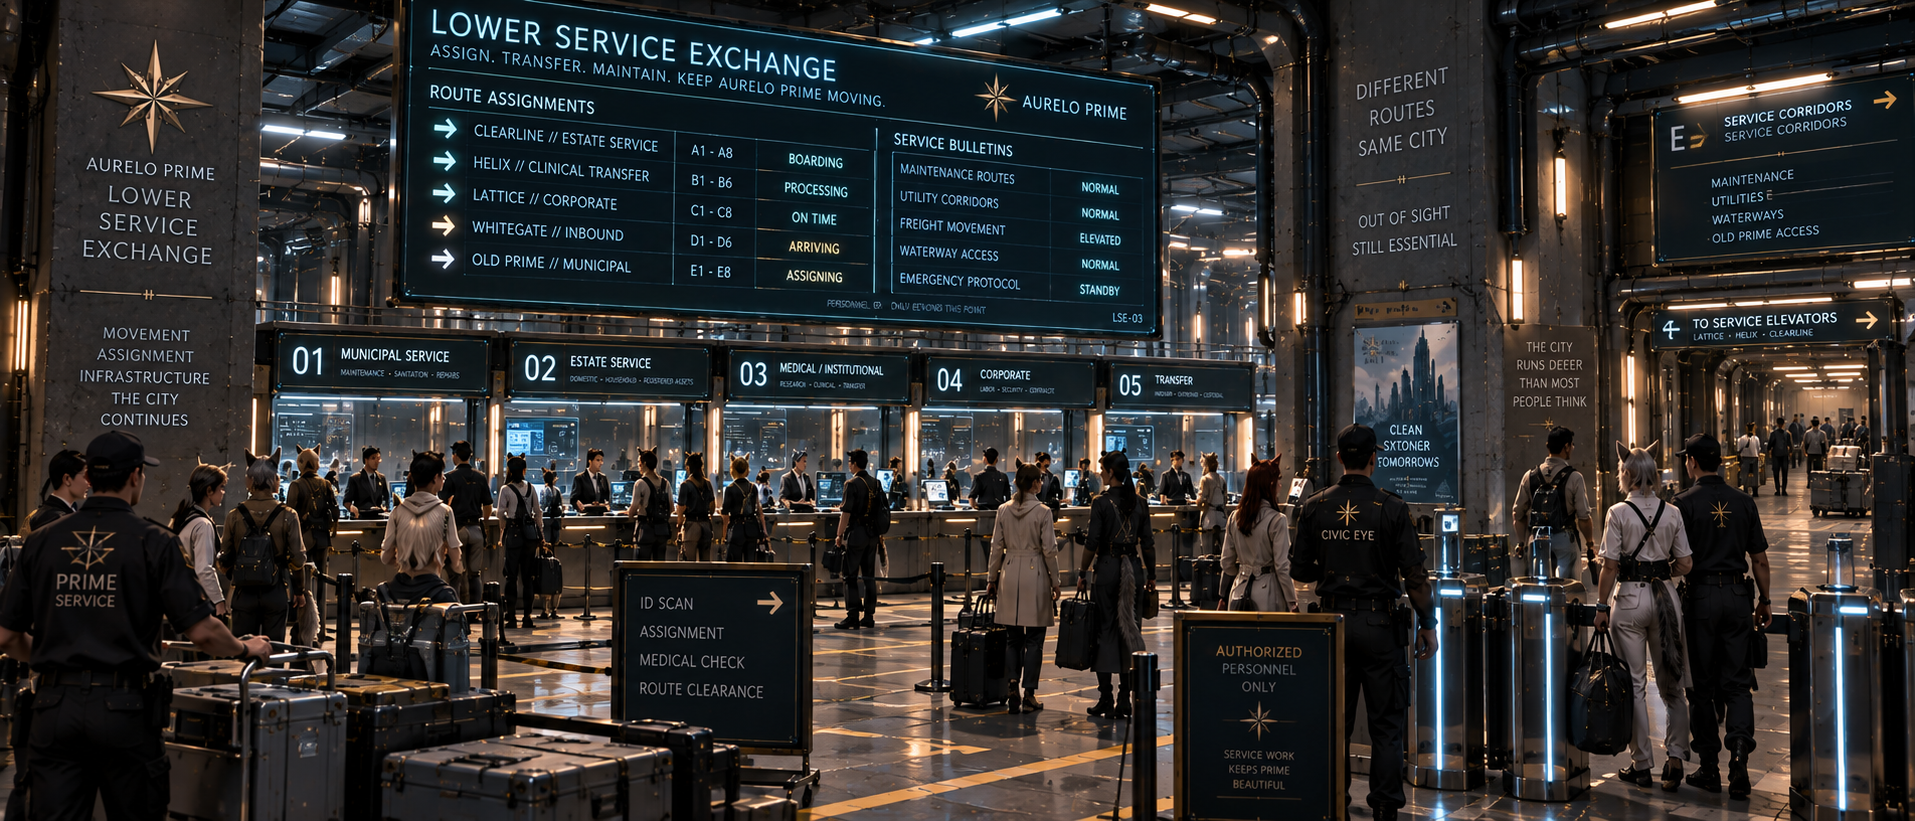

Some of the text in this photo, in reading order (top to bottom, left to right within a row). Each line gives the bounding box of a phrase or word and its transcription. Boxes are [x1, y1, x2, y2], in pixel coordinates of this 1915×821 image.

[432, 8, 836, 84] LOWER SERVICE EXCHANGE
[430, 44, 886, 108] ASSIGN. TRANSFER. MAINTAIN. KEEP AURELO PRIME MOVING.
[1356, 66, 1448, 100] DIFFERENT
[430, 84, 594, 114] ROUTE ASSIGNMENTS
[1022, 94, 1126, 120] AURELO PRIME
[1370, 100, 1434, 126] ROUTES
[1724, 100, 1852, 128] SERVICE CORRIDORS
[1724, 116, 1846, 142] SERVICE CORRIDORS
[474, 124, 544, 142] CLEARLINE
[562, 132, 606, 148] ESTATE
[610, 136, 658, 152] SERVICE
[894, 132, 1012, 158] SERVICE BULLETINS
[1358, 126, 1448, 156] SAME CITY
[1670, 124, 1686, 152] E
[692, 144, 732, 158] A1 A8
[788, 152, 844, 168] BOARDING
[86, 158, 214, 180] AURELO PRIME
[474, 156, 510, 170] HELIX
[528, 160, 584, 176] CLINICAL
[588, 166, 650, 182] TRANSFER
[900, 162, 1014, 184] MAINTENANCE ROUTES
[692, 174, 732, 188] B1 B6
[1712, 168, 1794, 188] MAINTENANCE
[108, 186, 192, 208] LOWER
[784, 182, 848, 198] PROCESSING
[1082, 182, 1120, 196] NORMAL
[474, 188, 524, 204] LATTICE
[542, 194, 618, 210] CORPORATE
[900, 190, 998, 208] UTILITY CORRIDORS
[1712, 192, 1764, 206] UTILITIES
[690, 204, 732, 218] C1 C8
[792, 212, 836, 226] ON TIME
[1082, 208, 1120, 220] NORMAL
[1358, 206, 1450, 228] OUT OF SIGHT
[1712, 208, 1784, 224] WATERWAYS
[100, 212, 198, 236] SERVICE
[472, 220, 548, 238] WHITEGATE
[566, 226, 624, 242] INBOUND
[900, 218, 1006, 236] FREIGHT MOVEMENT
[690, 234, 732, 248] D1 D6
[1080, 232, 1122, 246] ELEVATED
[1712, 224, 1820, 244] OLD PRIME ACCESS
[84, 240, 212, 264] EXCHANGE
[788, 240, 840, 254] ARRIVING
[1352, 232, 1458, 256] STILL ESSENTIAL
[900, 244, 998, 262] WATERWAY ACCESS
[472, 252, 500, 266] OLD
[506, 254, 544, 268] PRIME
[562, 258, 632, 274] MUNICIPAL
[690, 264, 730, 278] E1 E8
[1082, 258, 1120, 272] NORMAL
[786, 270, 842, 284] ASSIGNING
[900, 272, 1020, 290] EMERGENCY PROTOCOL
[1080, 284, 1120, 296] STANDBY
[1112, 312, 1142, 324] LSE-03
[1692, 312, 1838, 328] TO SERVICE ELEVATORS
[104, 326, 190, 342] MOVEMENT
[1694, 328, 1814, 340] LATTICE HELIX CLEARLINE
[96, 348, 194, 362] ASSIGNMENT
[342, 348, 450, 362] MUNICIPAL SERVICE
[1526, 342, 1572, 352] THE CITY
[292, 346, 322, 376] 01
[524, 354, 556, 382] 02
[570, 356, 652, 368] ESTATE SERVICE
[780, 362, 816, 374] MEDICAL
[824, 364, 884, 376] INSTITUTIONAL
[1516, 360, 1582, 370] RUNS DEEER
[80, 370, 210, 384] INFRASTRUCTURE
[740, 362, 768, 386] 03
[938, 368, 962, 392] 04
[980, 368, 1030, 380] CORPORATE
[1154, 374, 1194, 386] TRANSFER
[1120, 374, 1142, 396] 05
[1520, 378, 1580, 388] THAN MOST
[112, 392, 178, 406] THE CITY
[1512, 396, 1586, 408] PEOPLE THINK
[100, 412, 188, 426] CONTINUES
[1390, 424, 1422, 436] CLEAN
[1322, 530, 1374, 540] CIVIC EYE
[56, 574, 118, 590] PRIME
[56, 594, 116, 608] SERVICE
[640, 596, 694, 610] ID SCAN
[640, 626, 724, 640] ASSIGNMENT
[1216, 644, 1302, 658] AUTHORIZED
[640, 654, 744, 670] MEDICAL CHECK
[1222, 662, 1296, 676] PERSONNEL
[640, 682, 764, 698] ROUTE CLEARANCE
[1242, 680, 1276, 692] ONLY
[1224, 750, 1294, 760] SERVICE WORK
[1228, 764, 1290, 776] KEEPS PRIME
[1232, 780, 1286, 790] BEAUTIFUL
